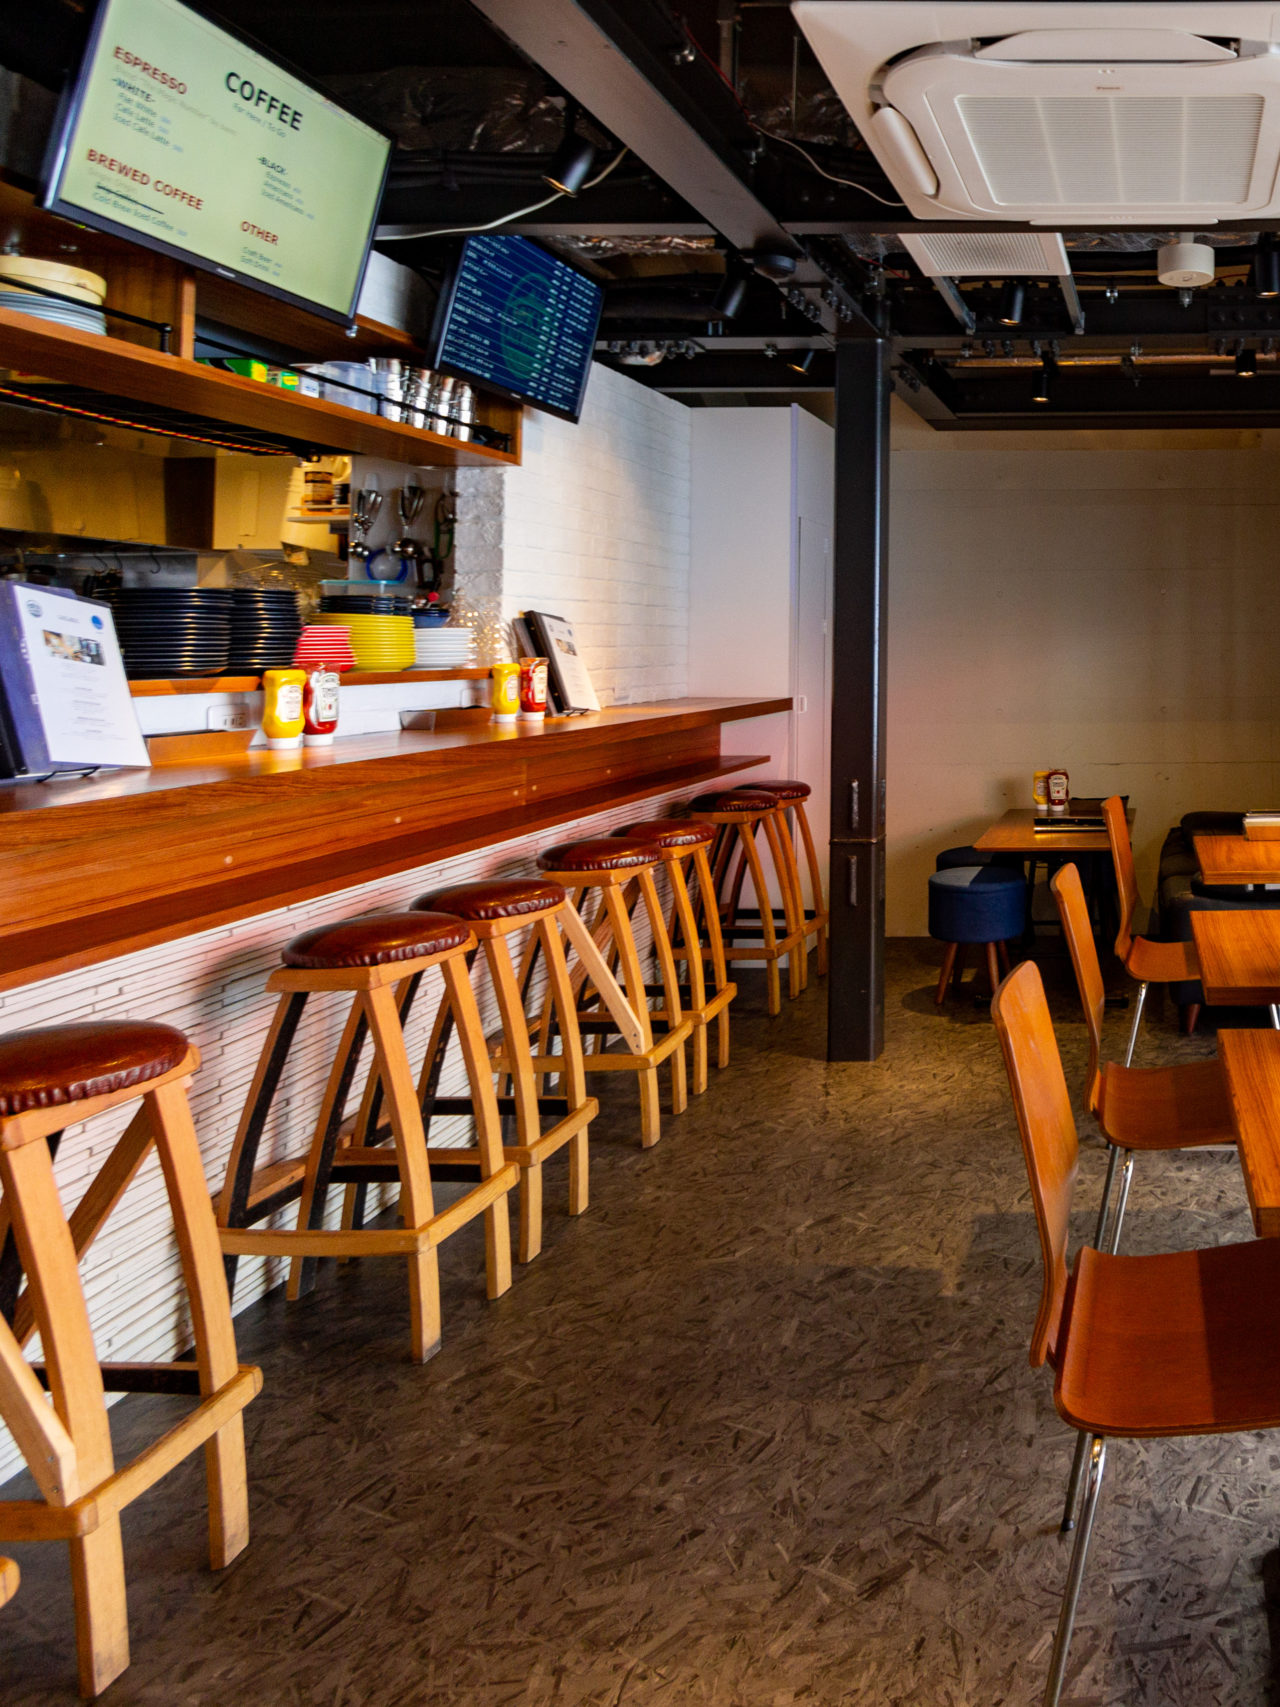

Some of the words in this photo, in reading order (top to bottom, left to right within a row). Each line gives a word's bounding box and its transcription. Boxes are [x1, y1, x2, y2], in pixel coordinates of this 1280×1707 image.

[114, 46, 187, 94] ESPRESSO
[225, 72, 303, 131] COFFEE
[87, 149, 150, 185] BREWED
[153, 180, 204, 211] COFFEE
[241, 221, 279, 246] OTHER
